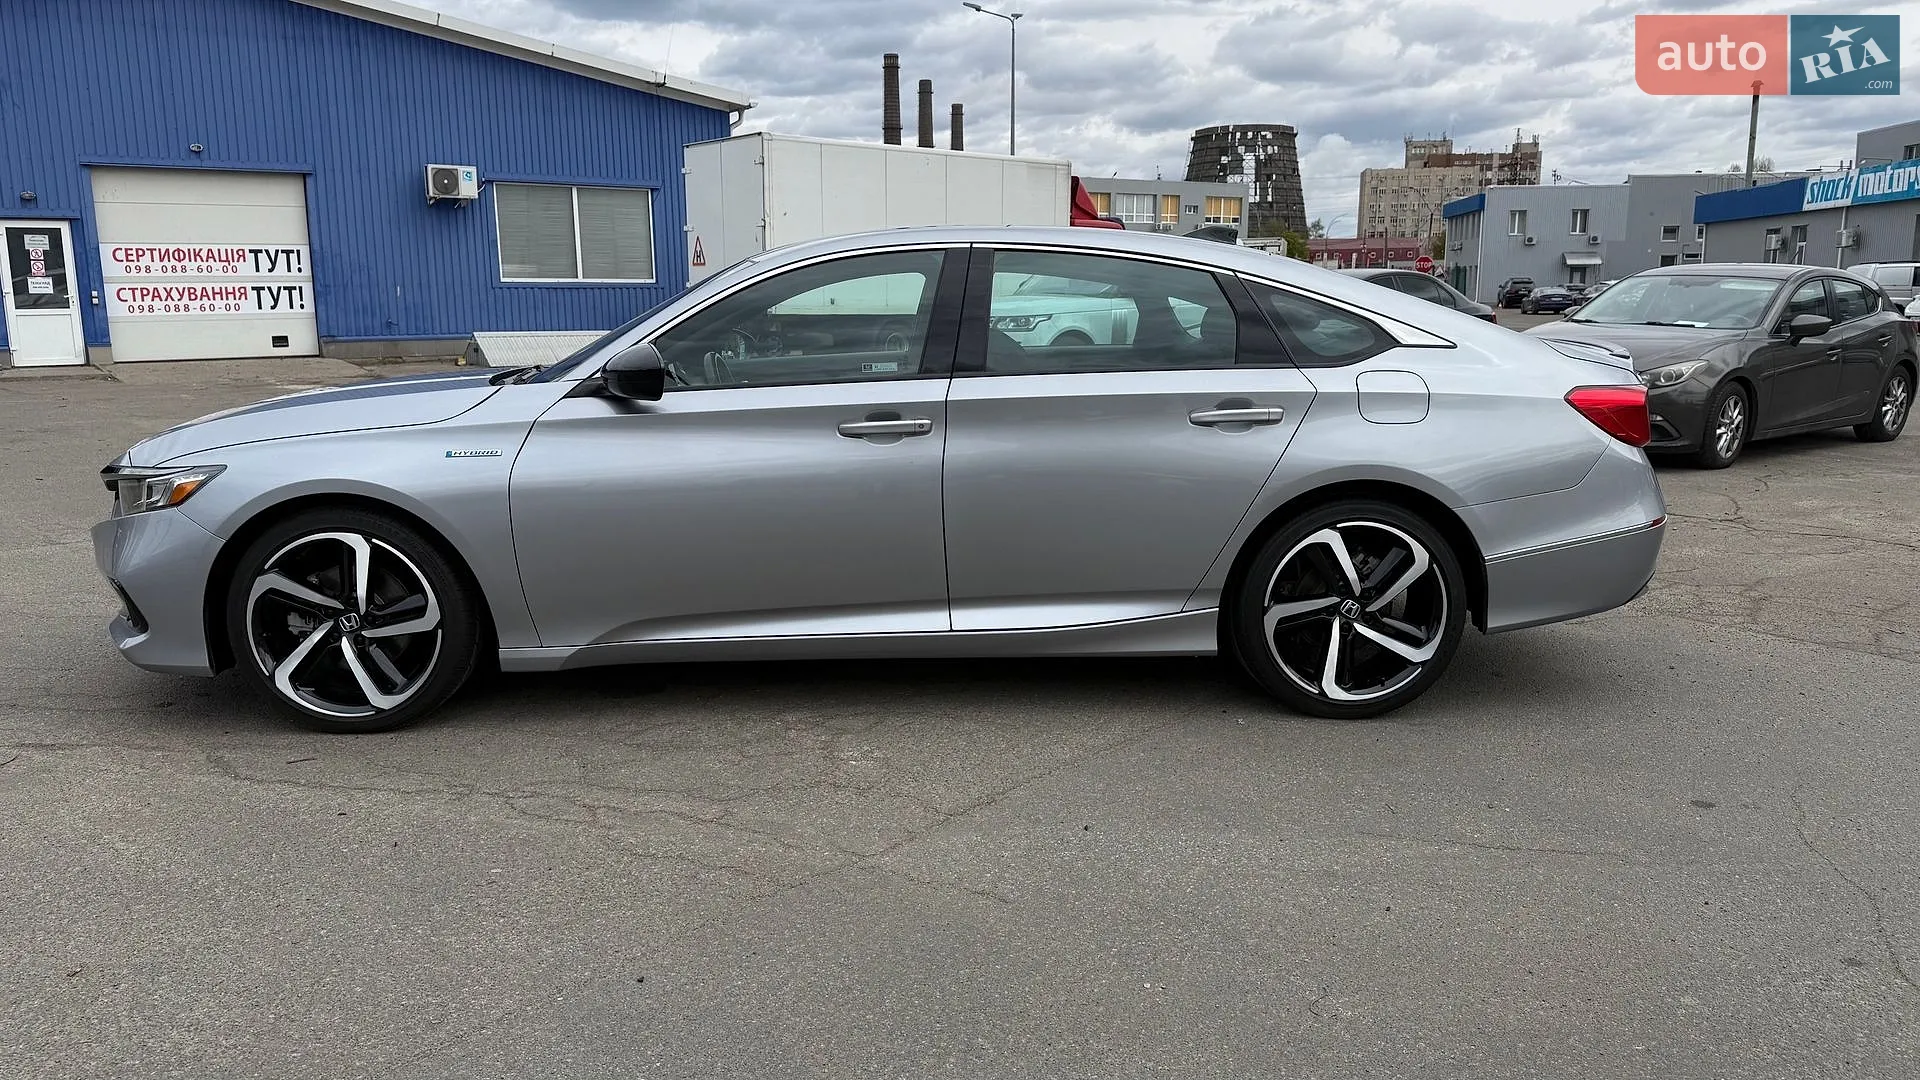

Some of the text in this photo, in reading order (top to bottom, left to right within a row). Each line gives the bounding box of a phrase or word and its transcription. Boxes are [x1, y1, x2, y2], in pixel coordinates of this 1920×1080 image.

[1806, 171, 1855, 204] shock
[112, 247, 303, 274] СЕРТИФІКАЦІЯ ТУТ!
[125, 264, 239, 274] 098-088-60-00
[1416, 261, 1432, 269] STOP
[116, 285, 305, 310] СТРАХУВАННЯ ТУТ!
[127, 303, 241, 313] 098-088-60-00
